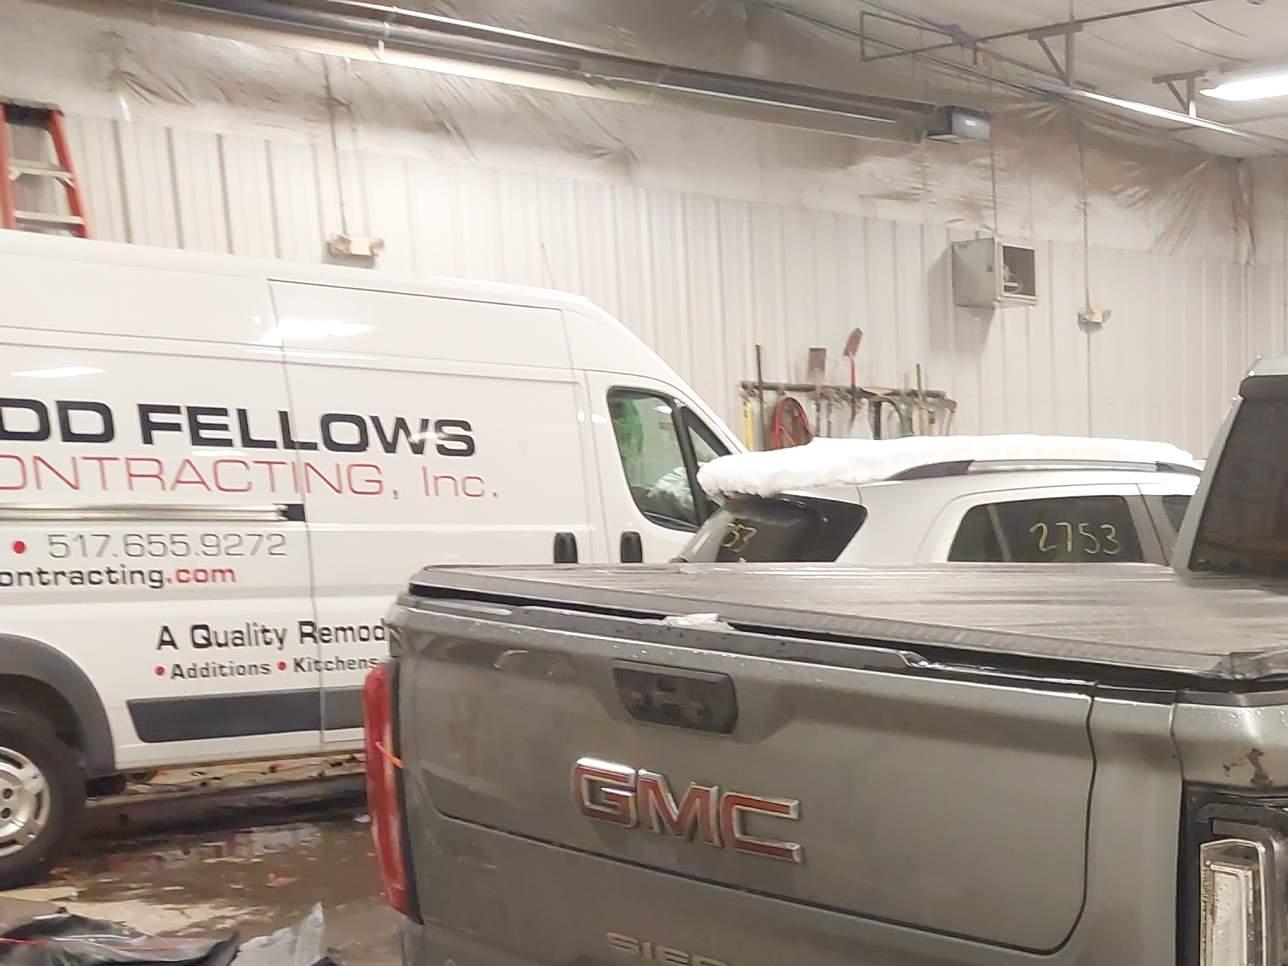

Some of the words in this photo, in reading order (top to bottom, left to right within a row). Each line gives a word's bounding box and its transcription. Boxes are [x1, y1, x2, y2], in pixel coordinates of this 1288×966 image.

[137, 403, 475, 457] FELLOWS
[421, 466, 498, 498] Inc.
[47, 533, 287, 558] 517.655.9272
[1030, 521, 1120, 555] 2753
[157, 625, 179, 650] A
[190, 622, 287, 650] Quality
[171, 662, 271, 680] Additions
[571, 757, 801, 863] GMC
